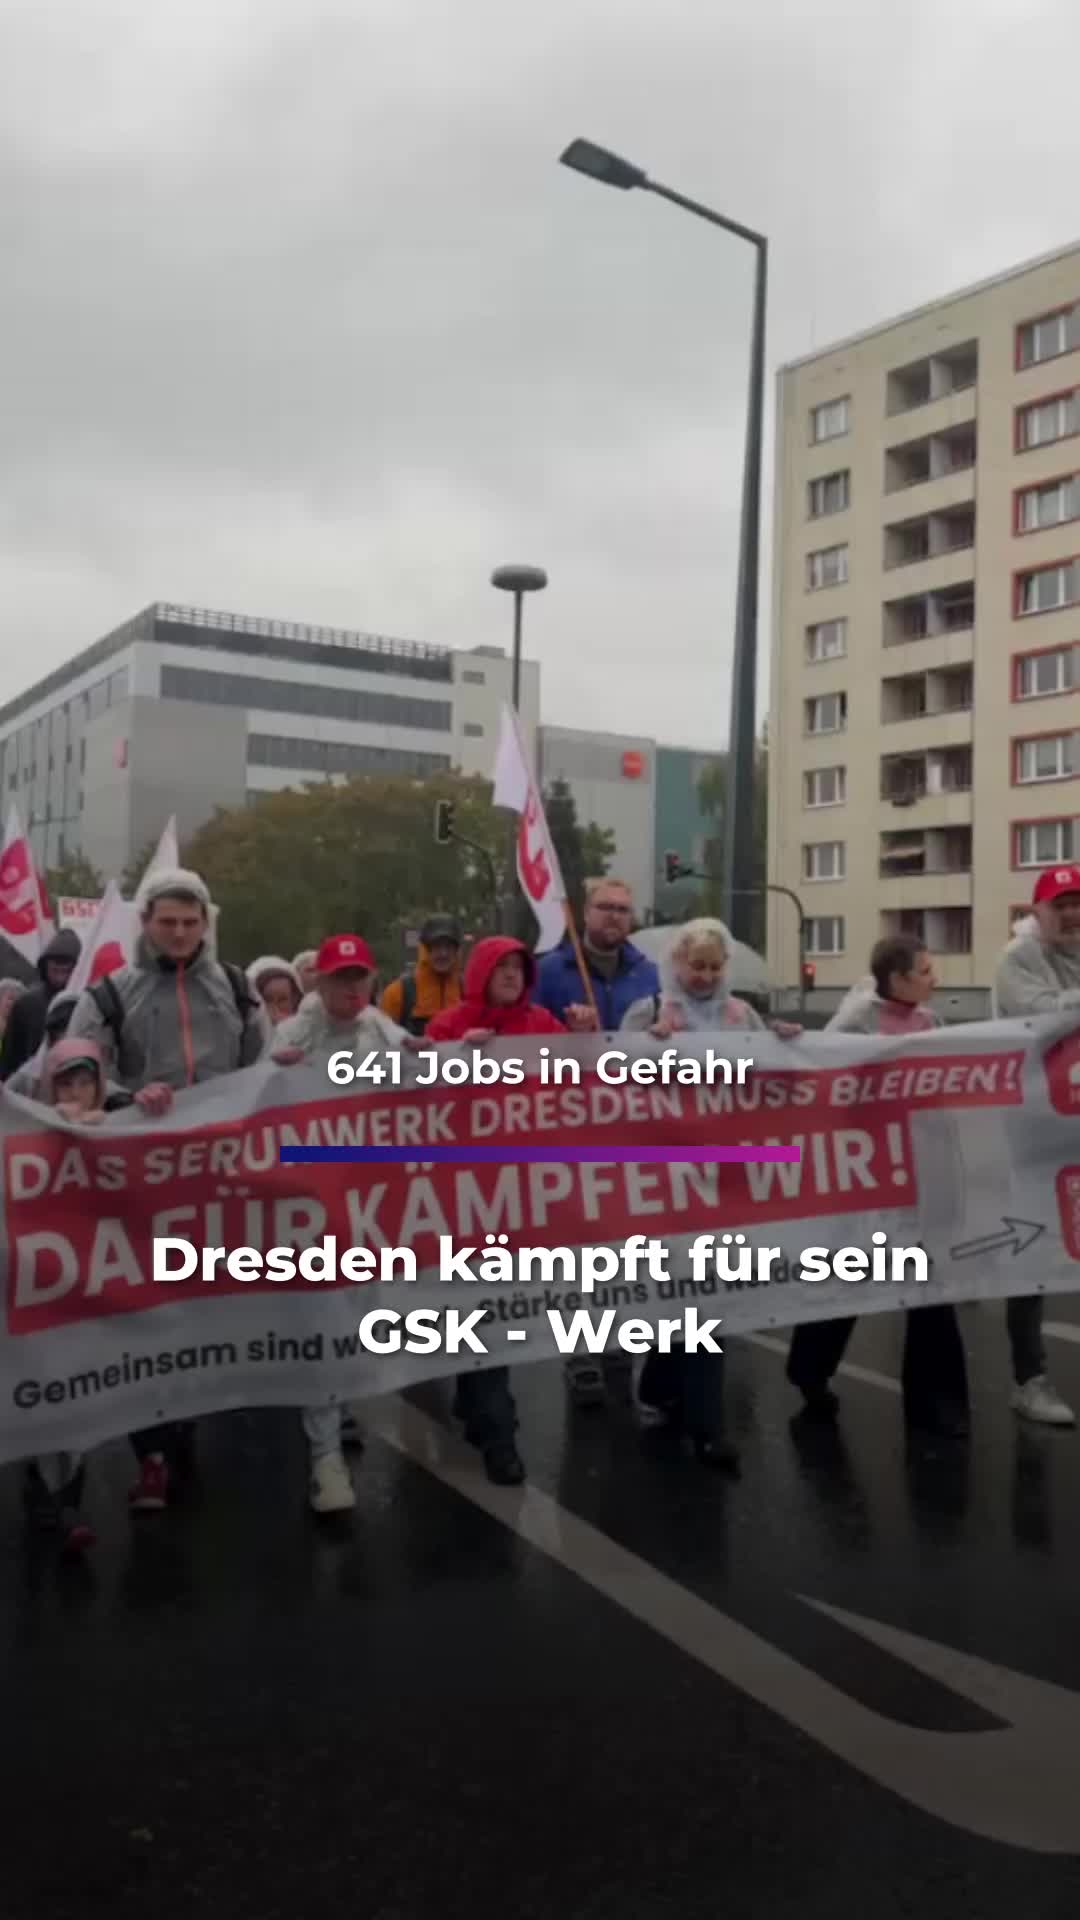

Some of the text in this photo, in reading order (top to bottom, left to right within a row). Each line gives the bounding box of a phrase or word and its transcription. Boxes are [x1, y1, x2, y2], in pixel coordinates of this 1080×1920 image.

[10, 1058, 1018, 1200] DAS SERUMWERK DRESDEN MUSS BLEIBEN!
[344, 1160, 721, 1262] KÄMPFEN
[738, 1121, 908, 1203] WIR!
[13, 1342, 237, 1409] Gemeinsam
[247, 1330, 324, 1361] sind
